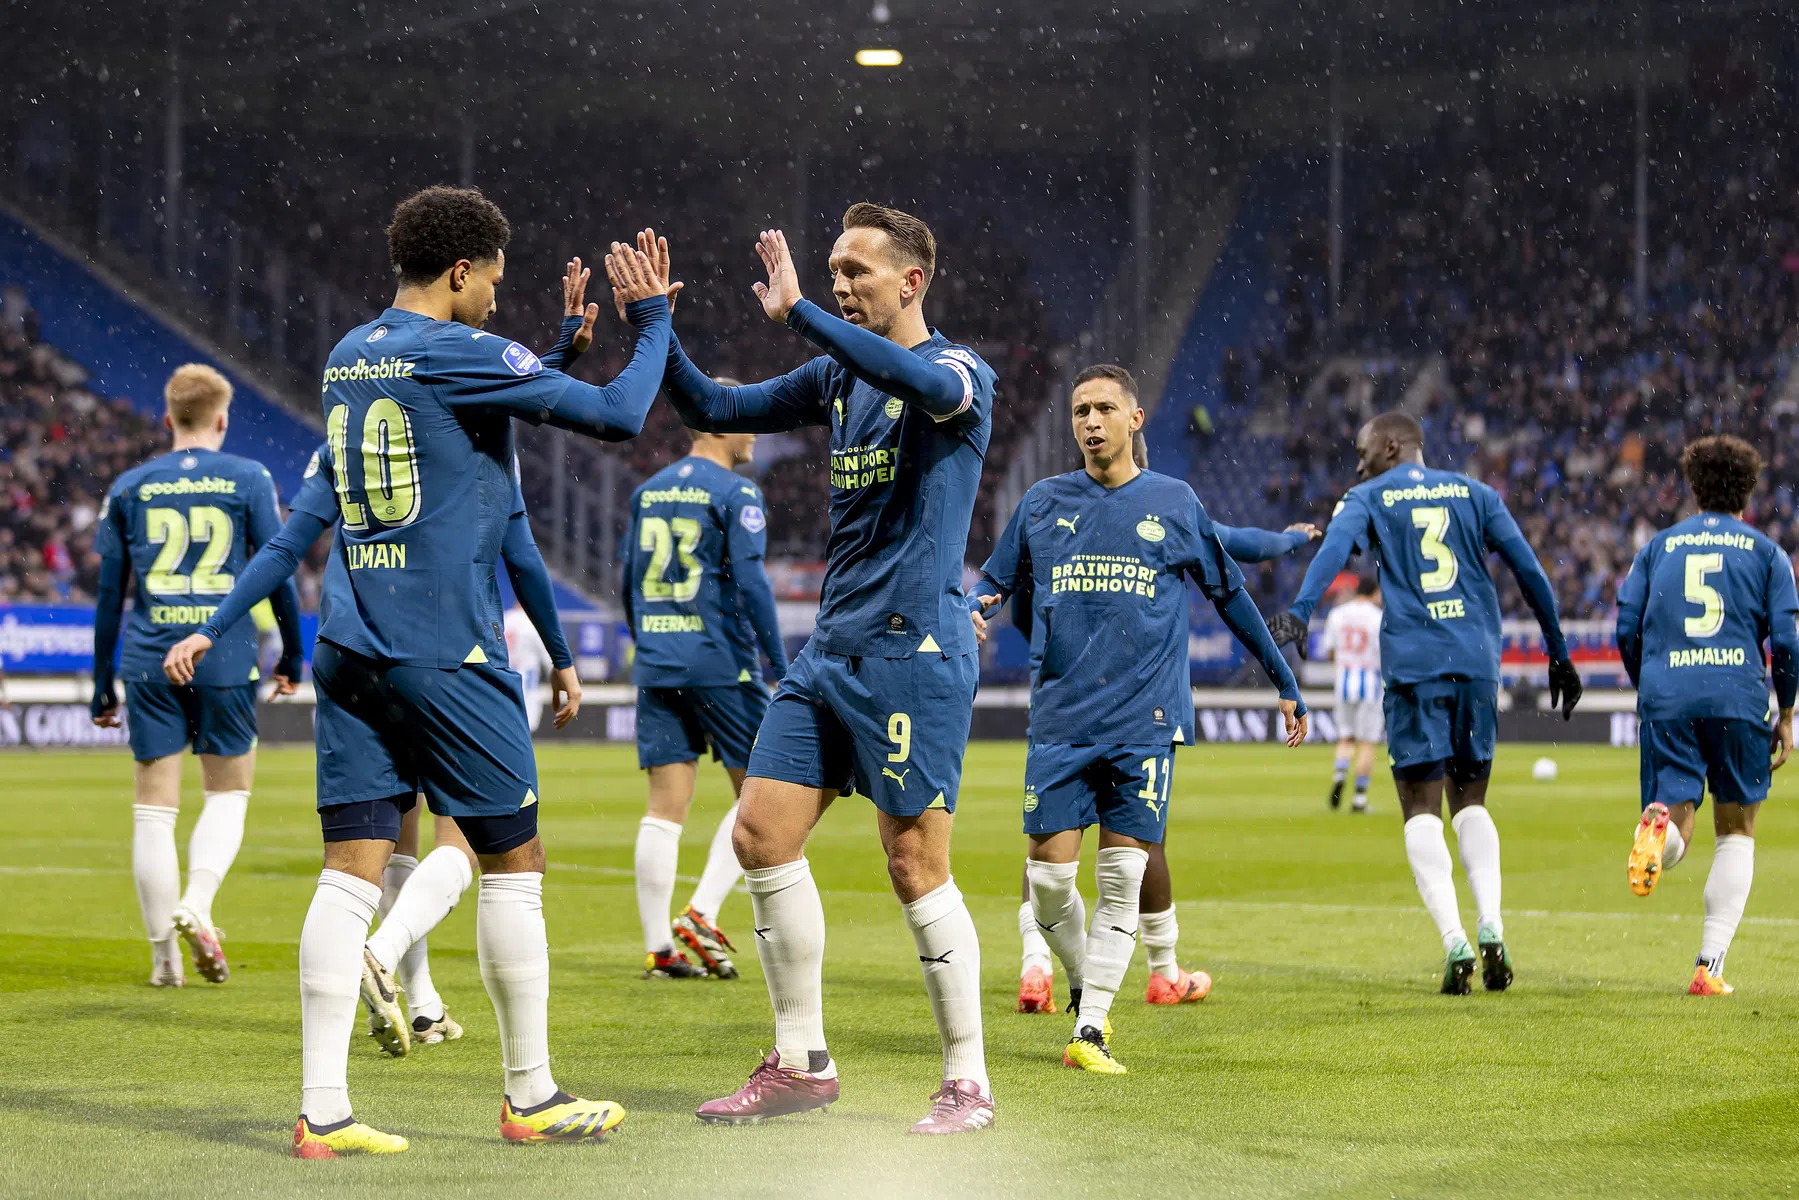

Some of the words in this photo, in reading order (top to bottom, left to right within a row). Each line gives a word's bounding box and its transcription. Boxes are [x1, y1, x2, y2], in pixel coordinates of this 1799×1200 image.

[322, 356, 416, 393] goodhabitz
[327, 398, 421, 530] 10
[139, 477, 236, 502] goodhabitz
[1382, 483, 1470, 508] goodhabitz
[146, 505, 235, 596] 22
[1411, 506, 1458, 593] 3
[1665, 531, 1755, 553] goodhabitz
[639, 516, 704, 603] 23
[1071, 554, 1141, 564] METROPOOLREGIO
[1052, 562, 1157, 583] BRAINPORT
[1052, 578, 1156, 599] EINDHOVEN
[1684, 552, 1724, 638] 5
[1426, 599, 1465, 620] TEZE
[1669, 647, 1745, 668] RAMALHO
[887, 712, 912, 763] 9
